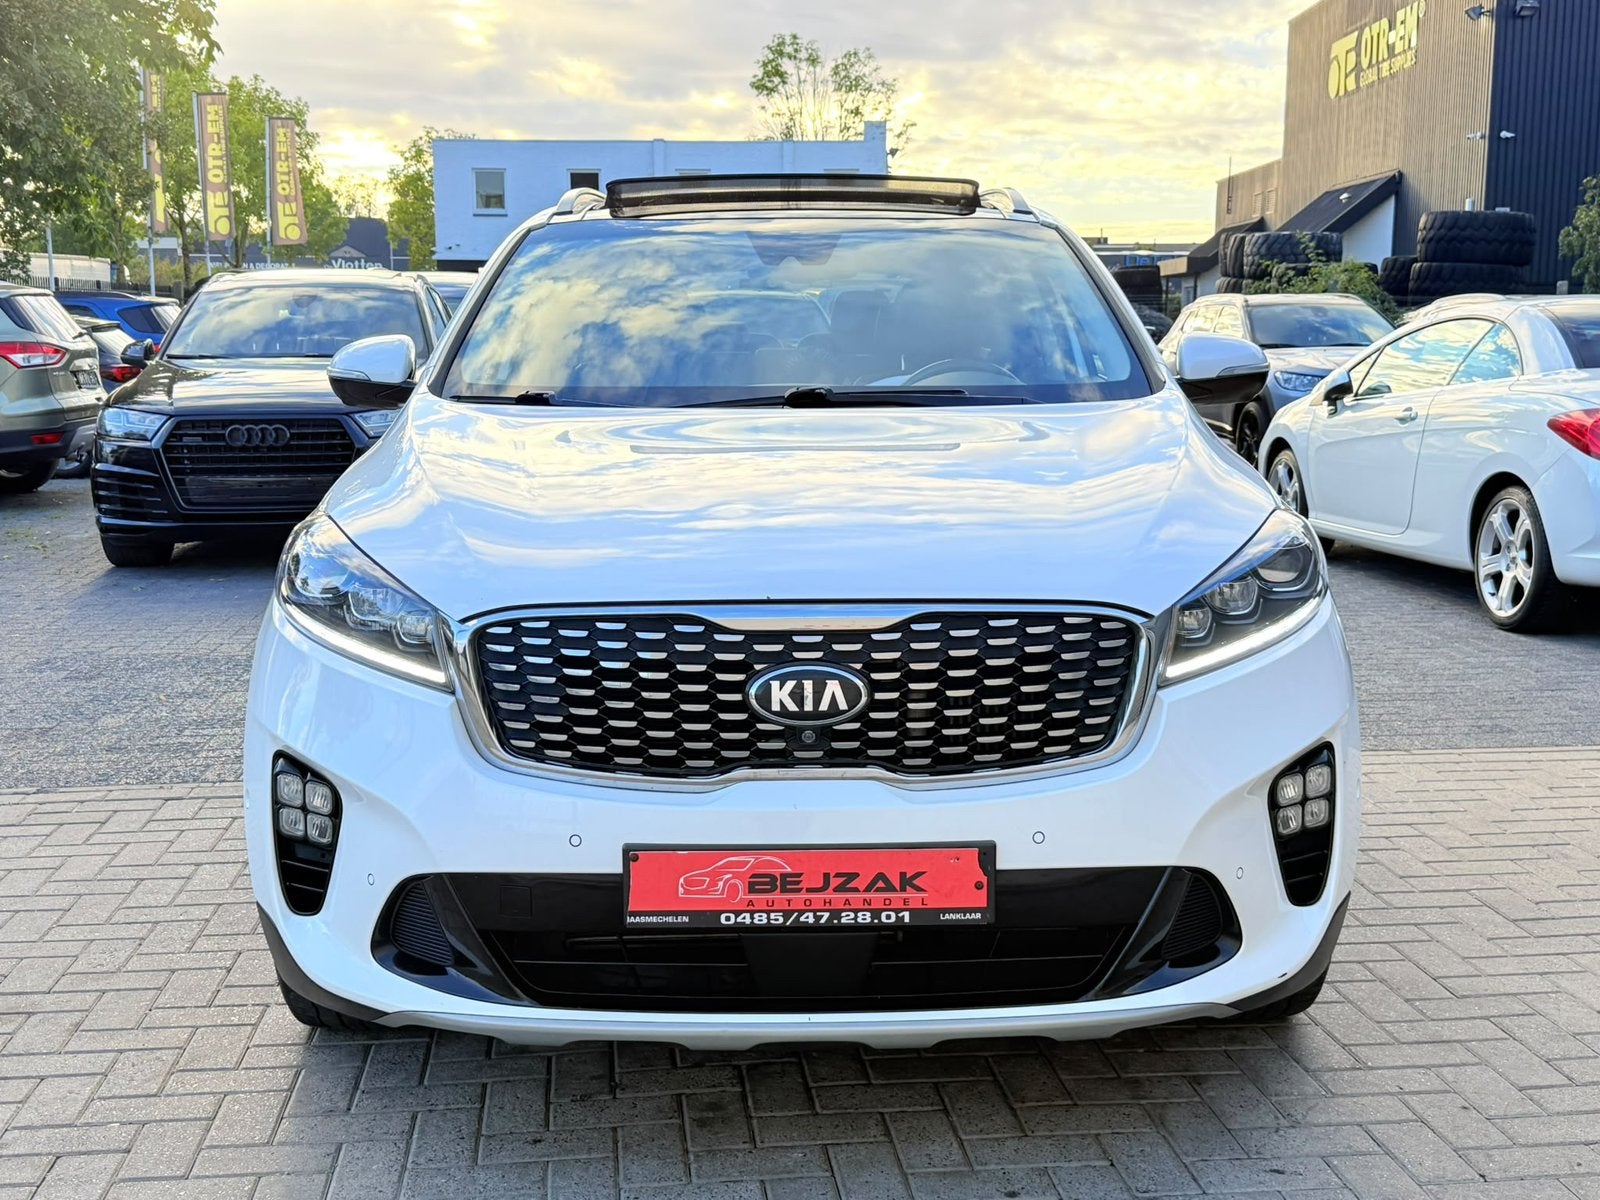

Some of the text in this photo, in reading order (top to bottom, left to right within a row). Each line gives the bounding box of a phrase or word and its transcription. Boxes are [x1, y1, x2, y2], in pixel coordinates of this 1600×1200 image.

[1361, 1, 1418, 70] OTR-EM
[207, 104, 224, 184] OTR-EM
[276, 128, 291, 196] OTR-EM
[769, 679, 849, 712] KIA
[748, 870, 929, 894] BEJZAK
[719, 910, 911, 926] 0485/47.28.01
[940, 912, 982, 920] LANKLAAR
[746, 897, 928, 908] AUTOHANDEL
